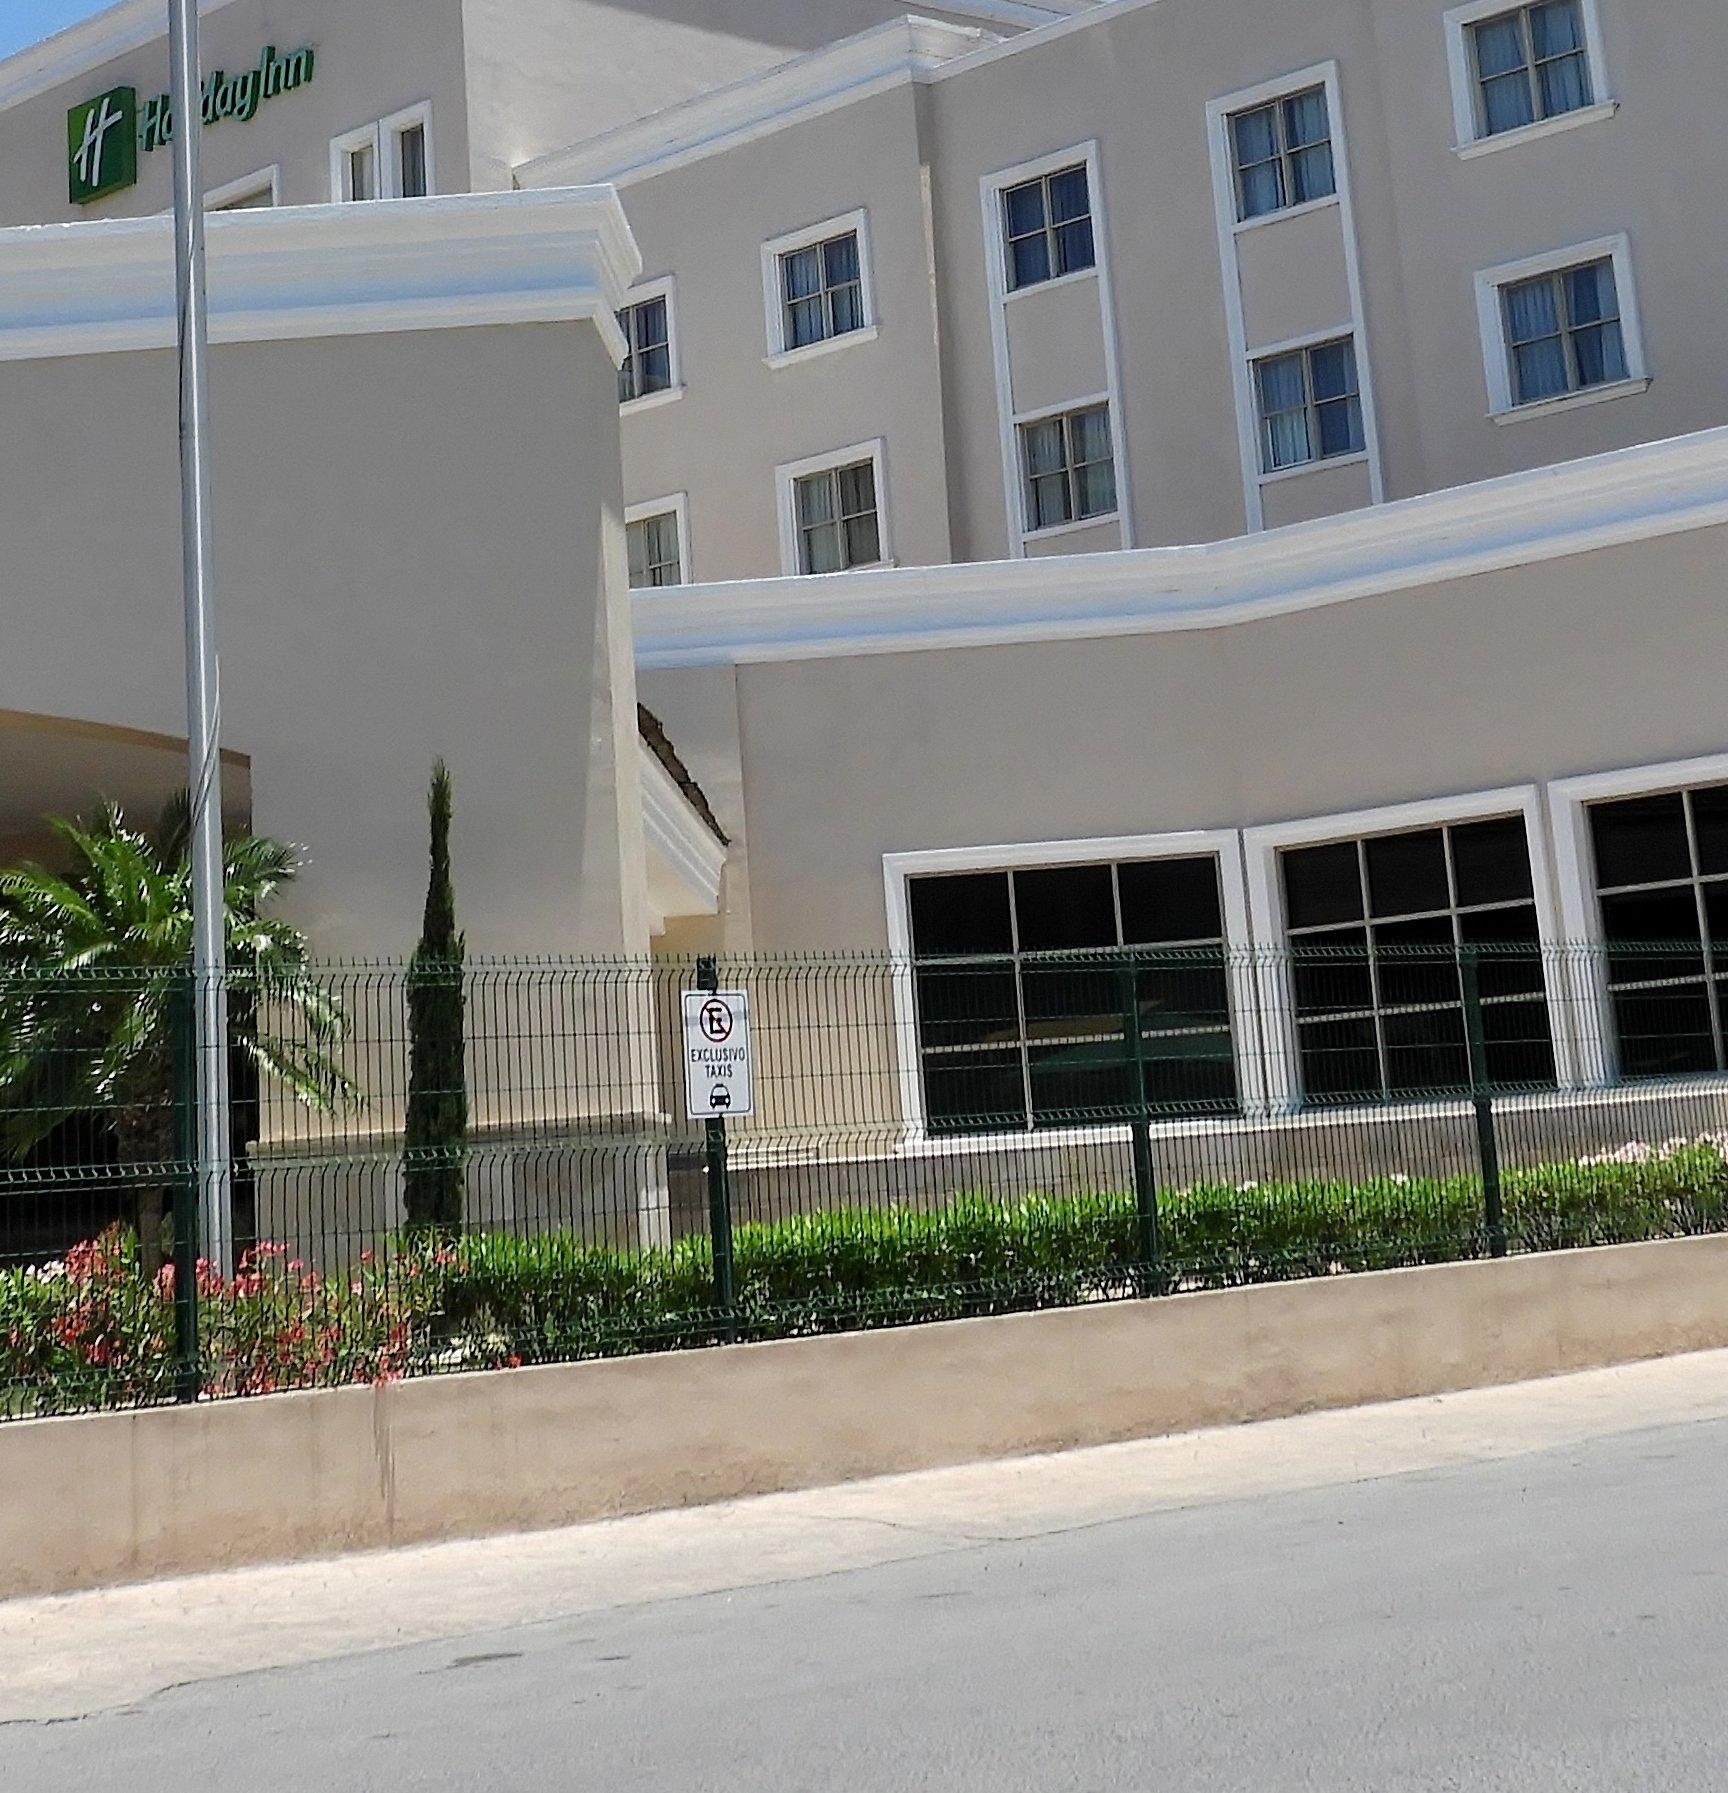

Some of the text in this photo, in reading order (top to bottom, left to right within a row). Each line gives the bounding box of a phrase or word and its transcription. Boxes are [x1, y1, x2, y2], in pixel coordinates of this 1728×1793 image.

[138, 45, 315, 152] Hoday Inn
[691, 1047, 746, 1062] EXCLUSIVO
[705, 1064, 733, 1078] TAXIS
